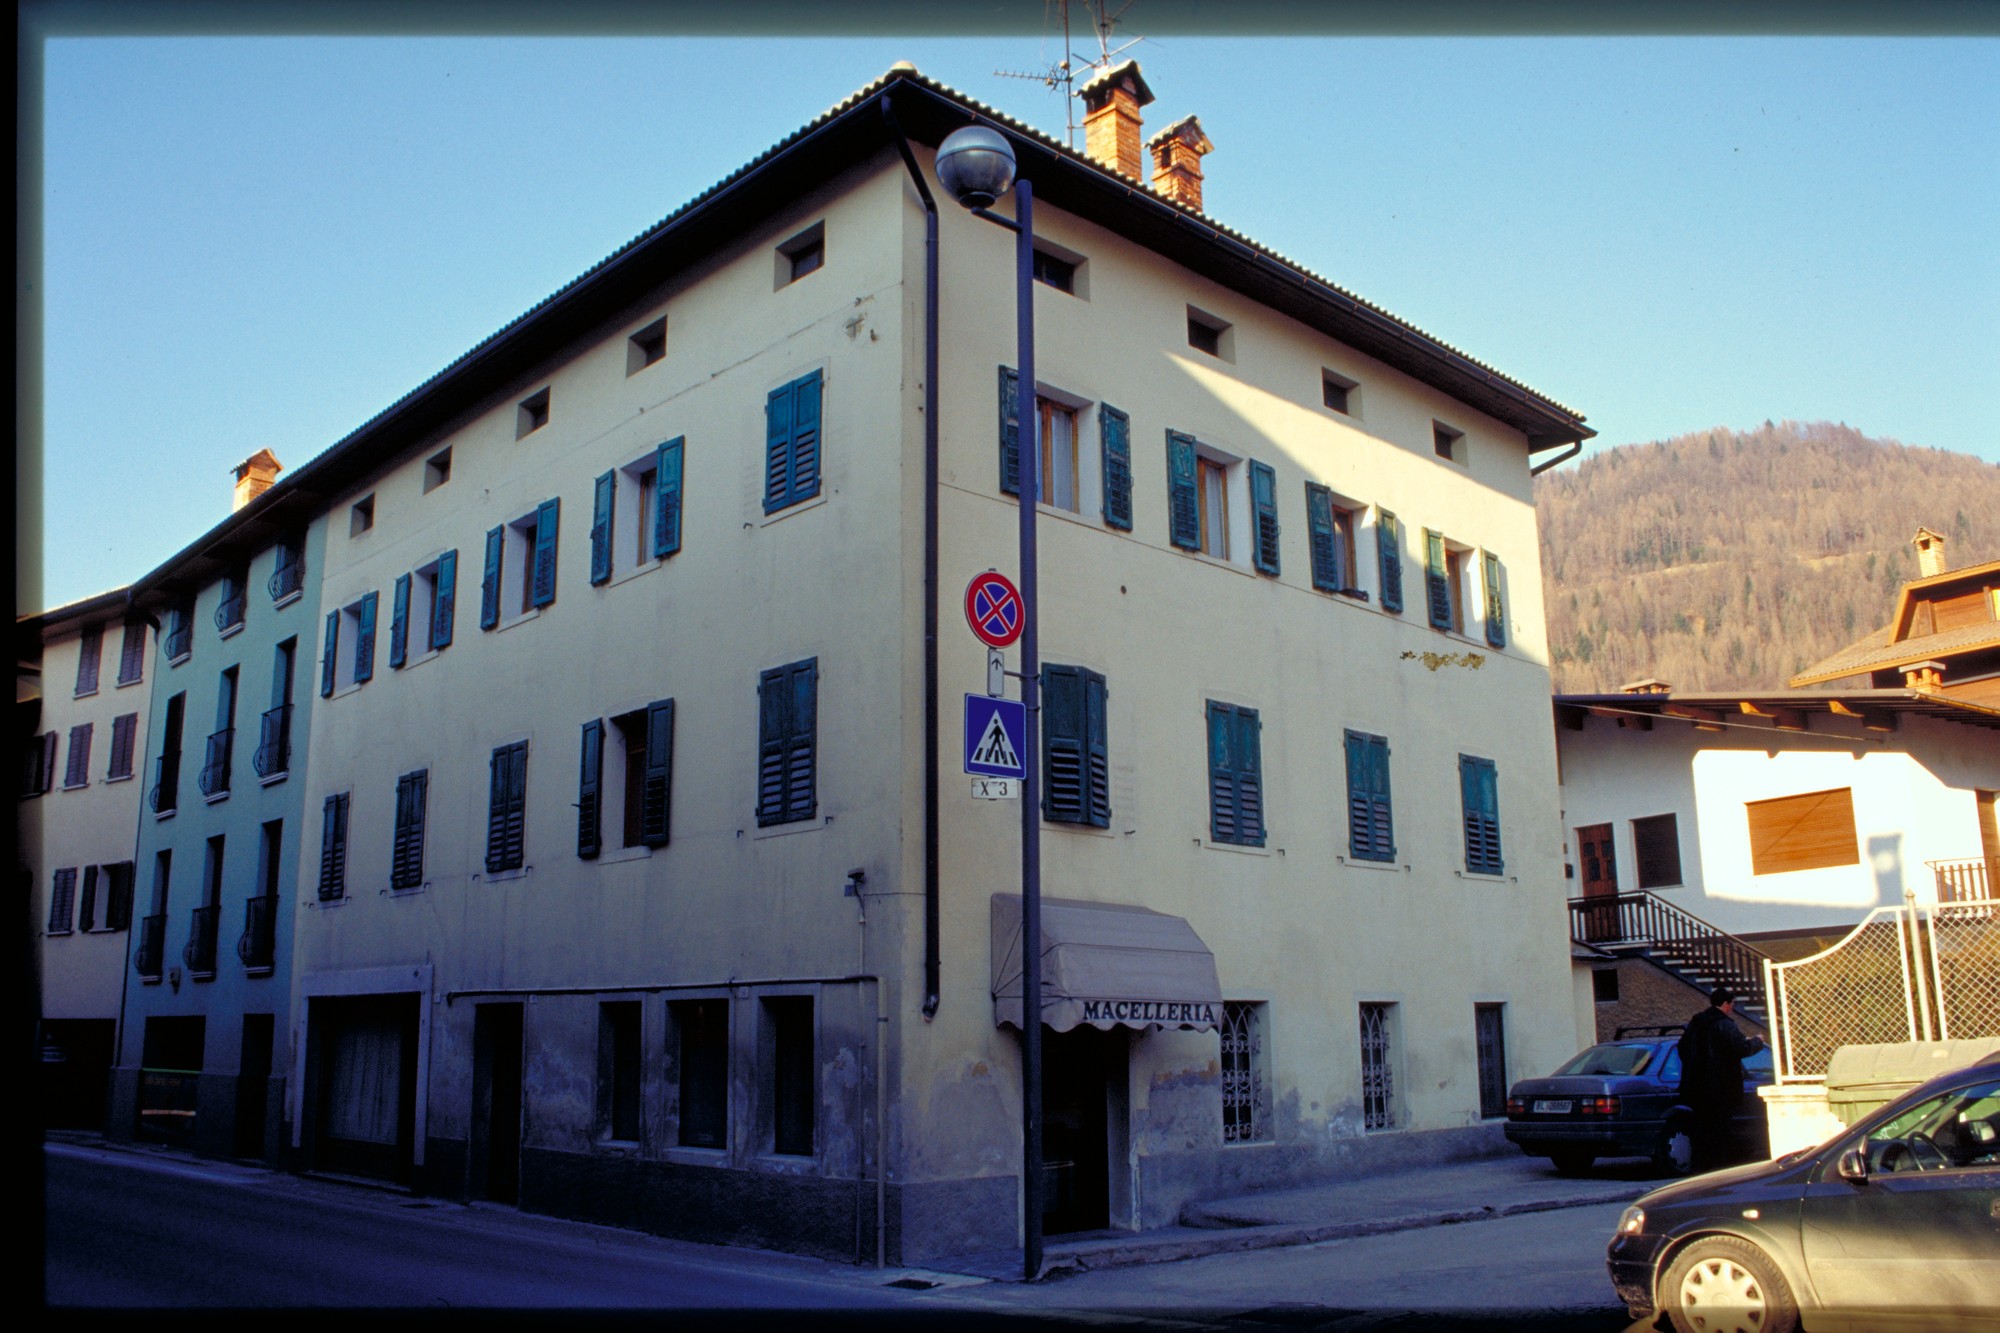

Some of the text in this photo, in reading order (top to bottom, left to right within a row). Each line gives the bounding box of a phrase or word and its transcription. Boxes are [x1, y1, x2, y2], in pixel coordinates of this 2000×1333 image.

[980, 781, 1008, 796] X 3
[1082, 1001, 1215, 1023] MACELLERIA
